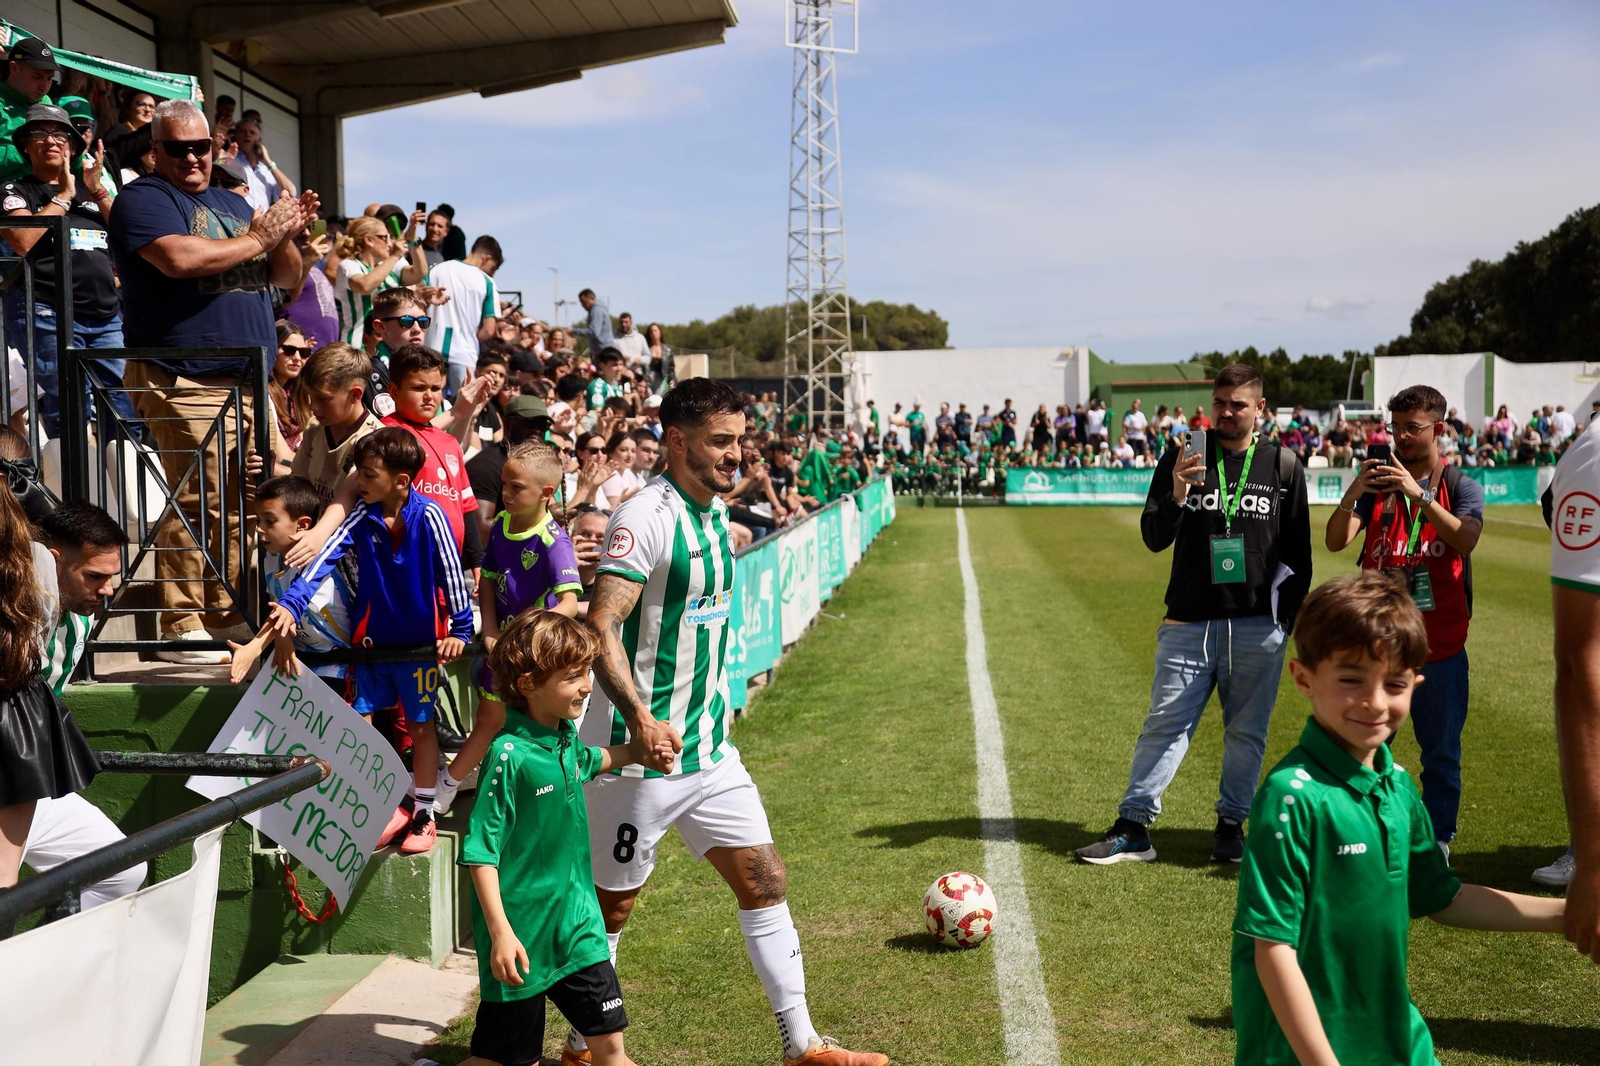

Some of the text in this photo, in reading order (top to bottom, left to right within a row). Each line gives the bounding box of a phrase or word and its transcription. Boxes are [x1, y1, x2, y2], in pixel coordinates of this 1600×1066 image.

[1056, 473, 1118, 484] CARIHUELA
[1187, 488, 1271, 514] adas
[1252, 513, 1270, 521] SPORT
[1566, 505, 1596, 520] RF
[1563, 522, 1593, 536] EF
[688, 549, 704, 560] JAKO
[413, 667, 439, 694] 10
[248, 710, 287, 756] TÚ
[335, 728, 396, 806] PARA
[535, 784, 554, 796] JAKO
[613, 822, 639, 864] 8
[1336, 843, 1367, 855] JAKO
[602, 997, 623, 1012] JAKO
